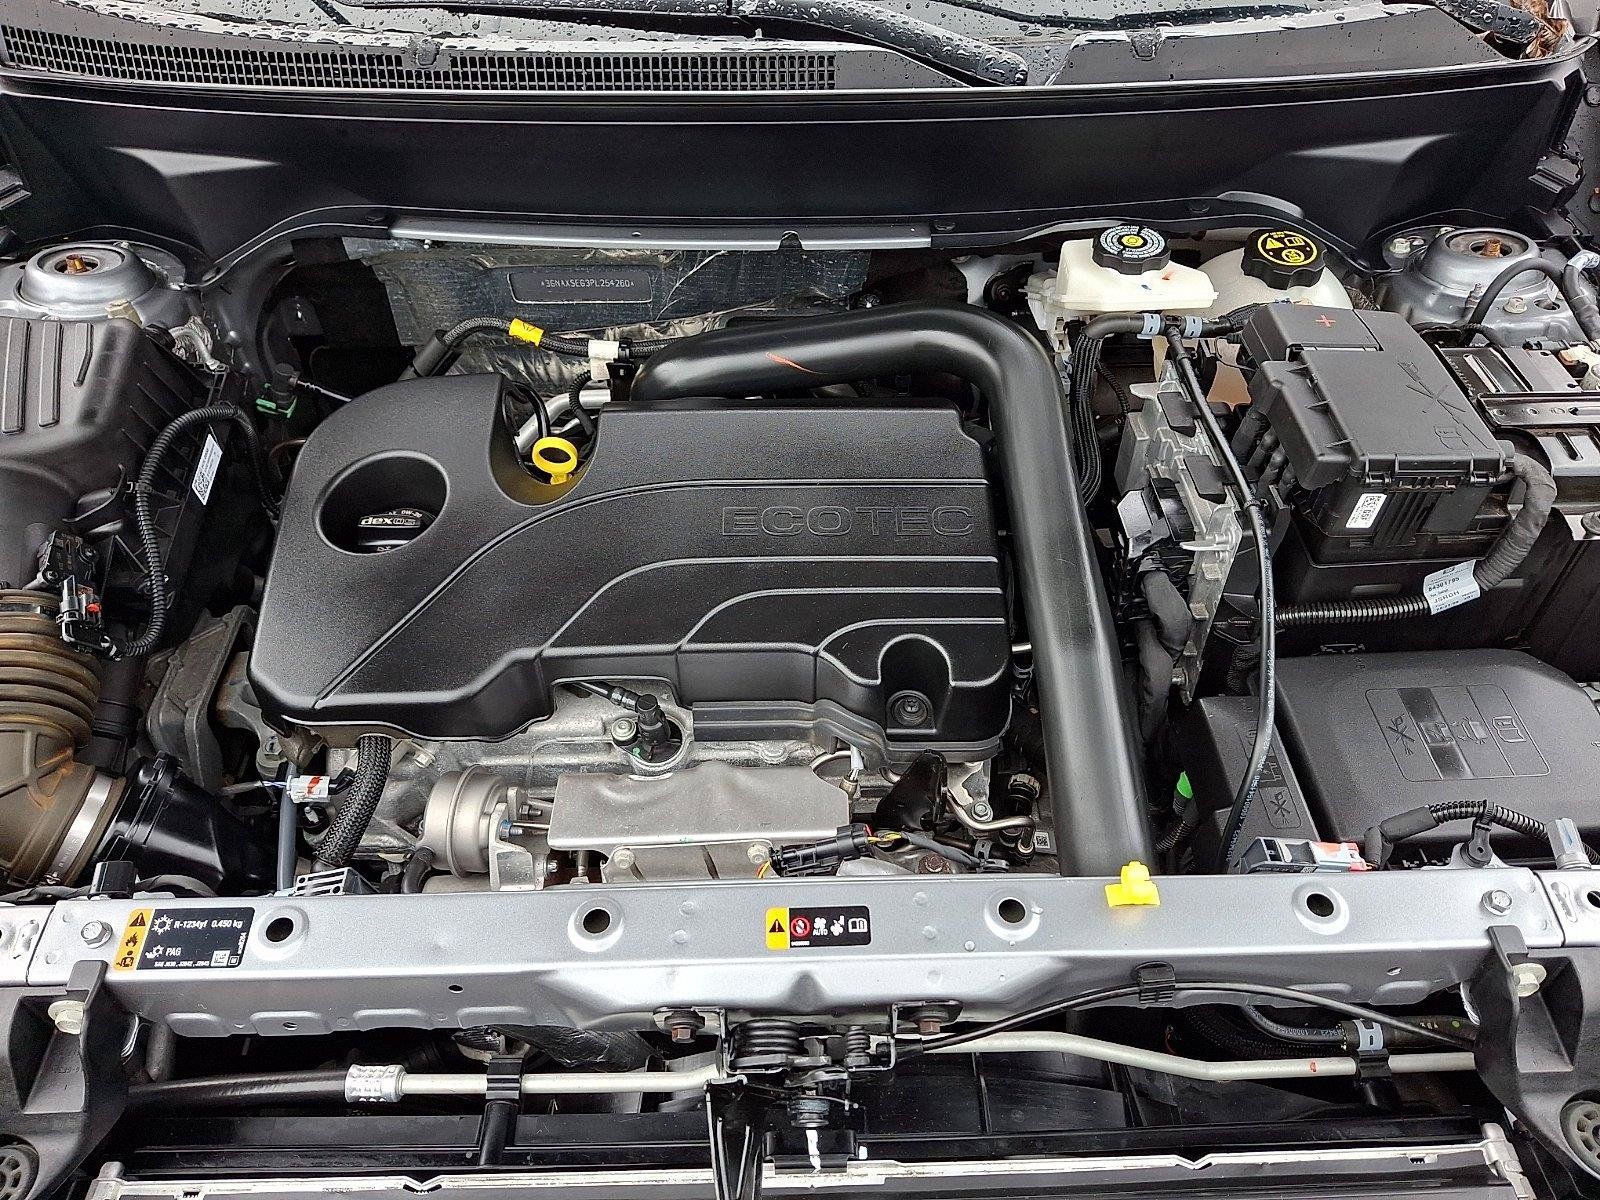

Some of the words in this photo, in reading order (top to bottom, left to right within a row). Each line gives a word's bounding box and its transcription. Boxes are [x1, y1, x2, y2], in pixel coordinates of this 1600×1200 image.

[360, 517, 416, 526] dexos
[722, 506, 974, 536] ECOTEC
[812, 928, 829, 936] AUTO
[165, 947, 182, 957] PAG
